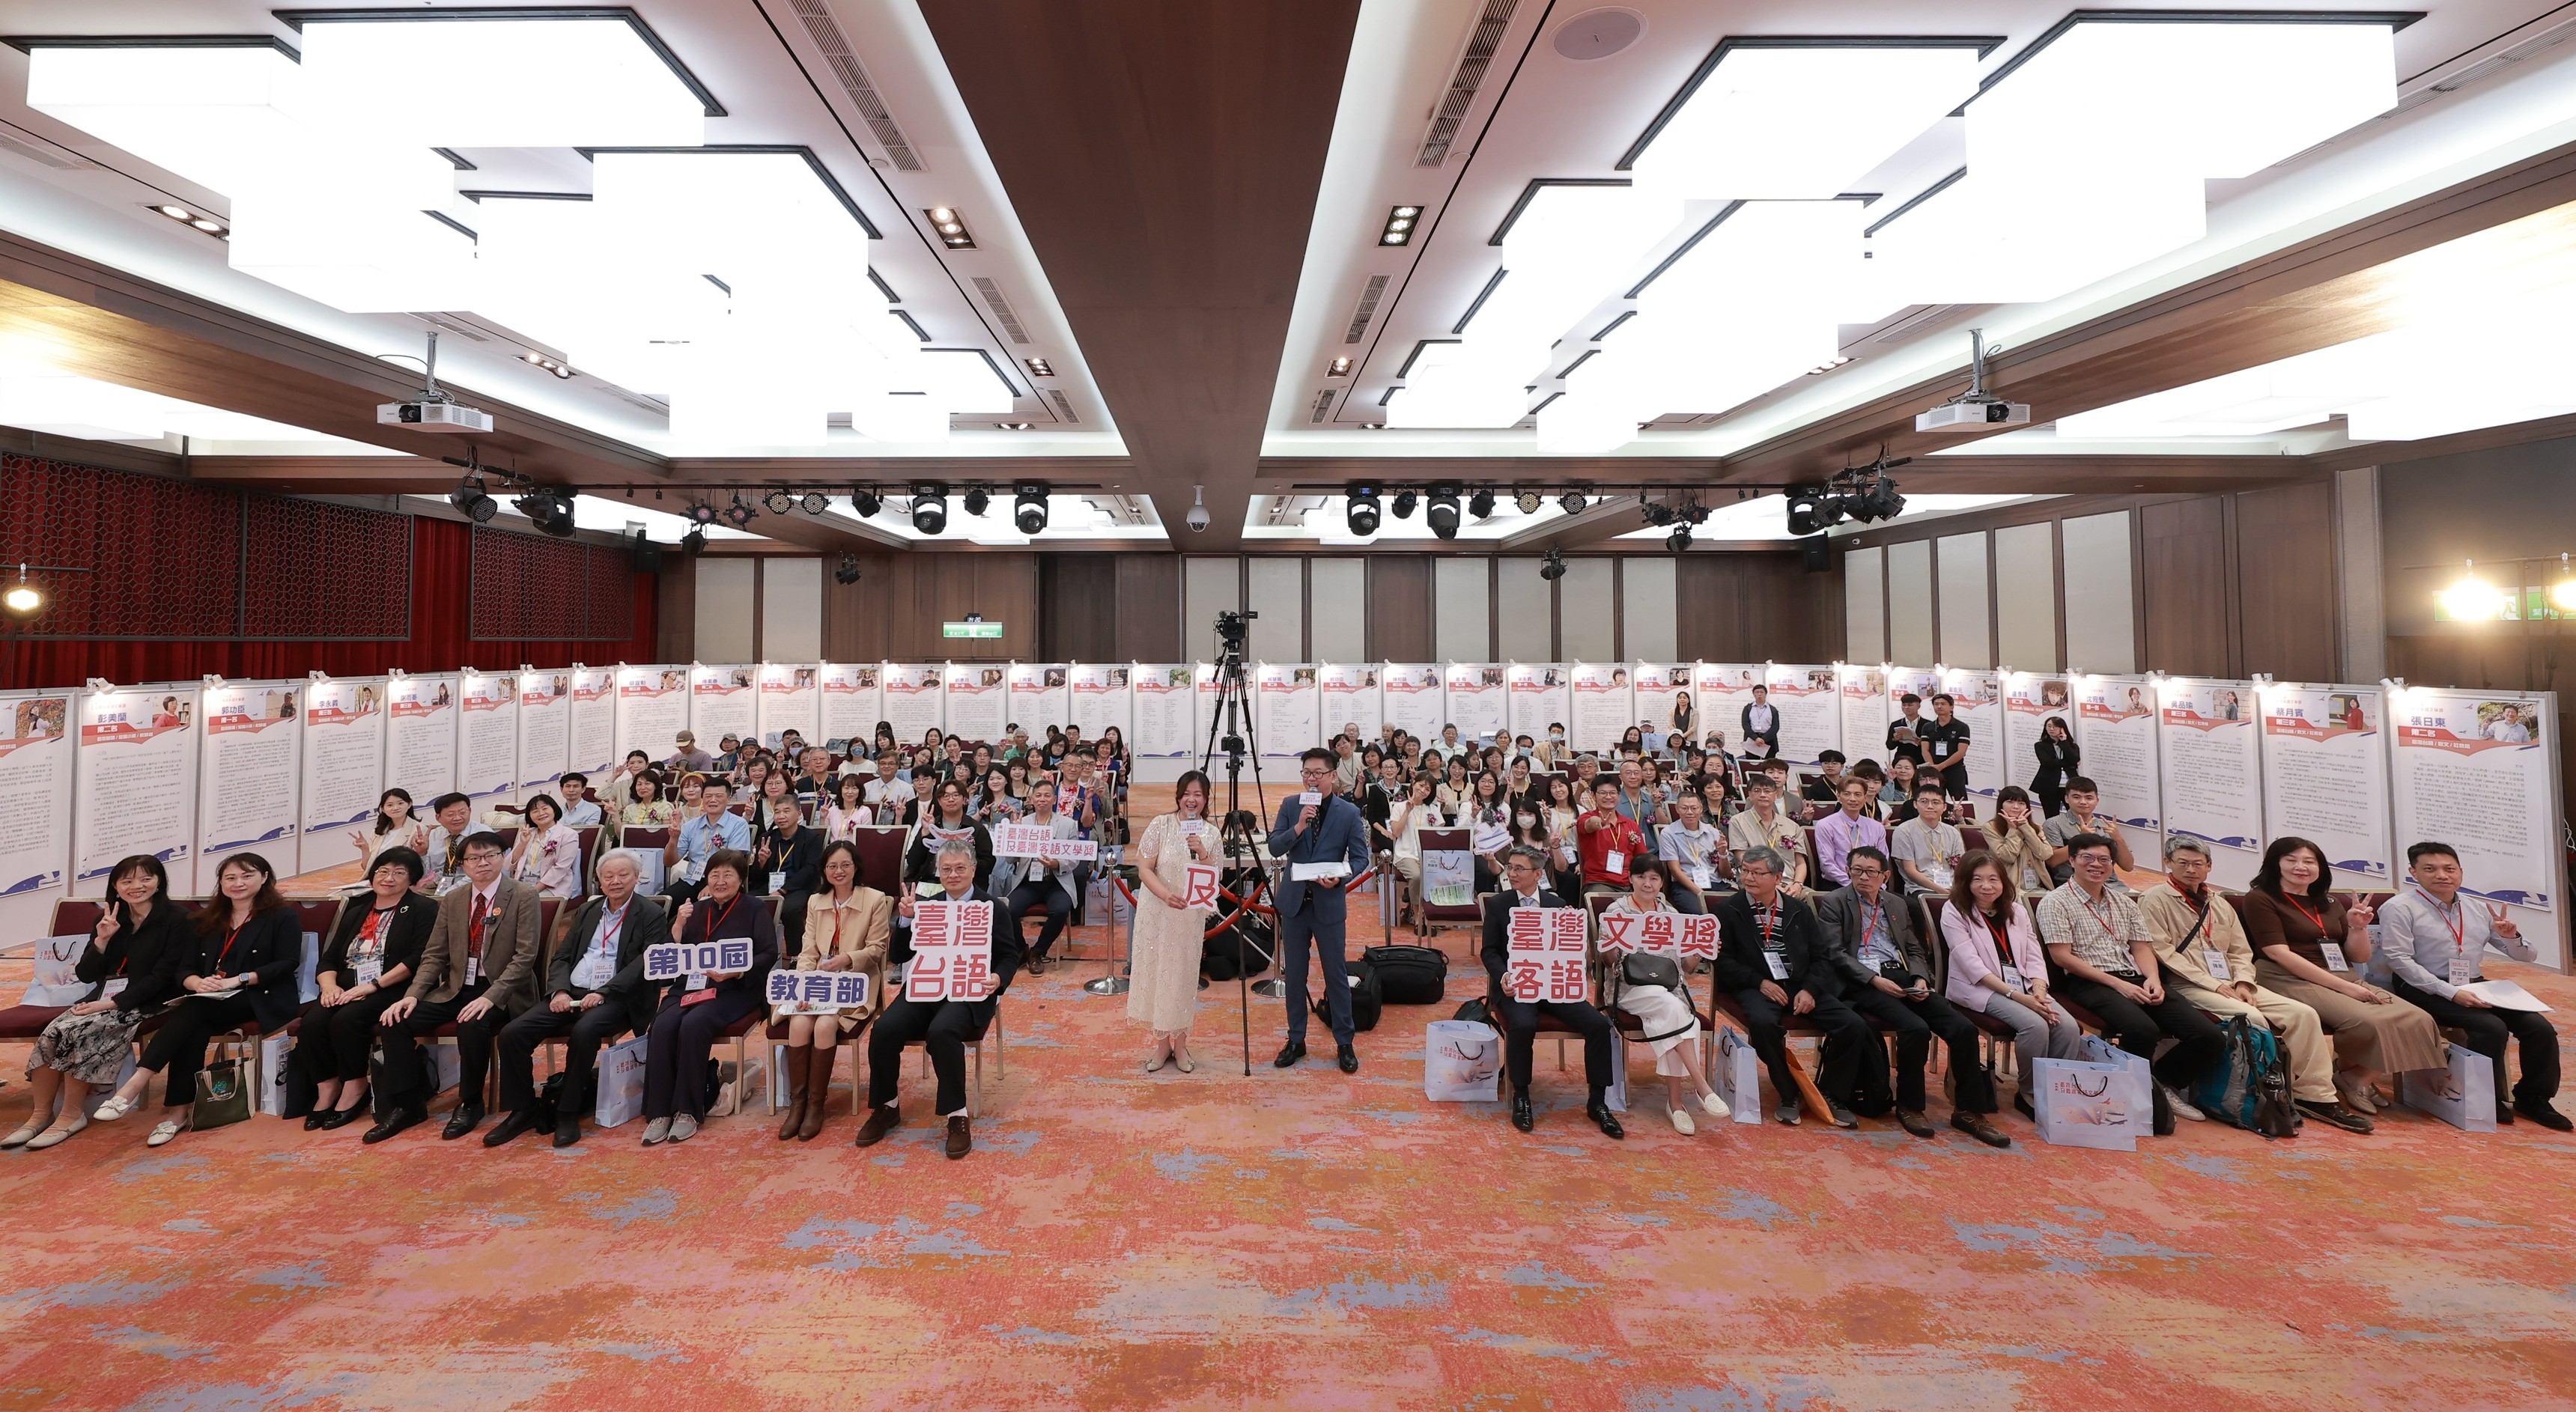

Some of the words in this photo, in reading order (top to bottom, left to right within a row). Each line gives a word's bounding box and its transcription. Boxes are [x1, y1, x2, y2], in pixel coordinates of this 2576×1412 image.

[97, 712, 127, 723] 彭美蘭
[2411, 716, 2446, 728] 張日東
[1006, 841, 1095, 856] 及臺灣客語文學獎
[1007, 827, 1051, 841] 臺灣台語
[1186, 867, 1216, 908] 及
[914, 904, 990, 946] 臺灣
[1511, 910, 1585, 952] 臺灣
[1602, 913, 1717, 957] 文學獎
[648, 943, 748, 976] 第10屆
[910, 953, 988, 998] 台語
[771, 975, 865, 1003] 教育部
[1512, 958, 1584, 999] 客語
